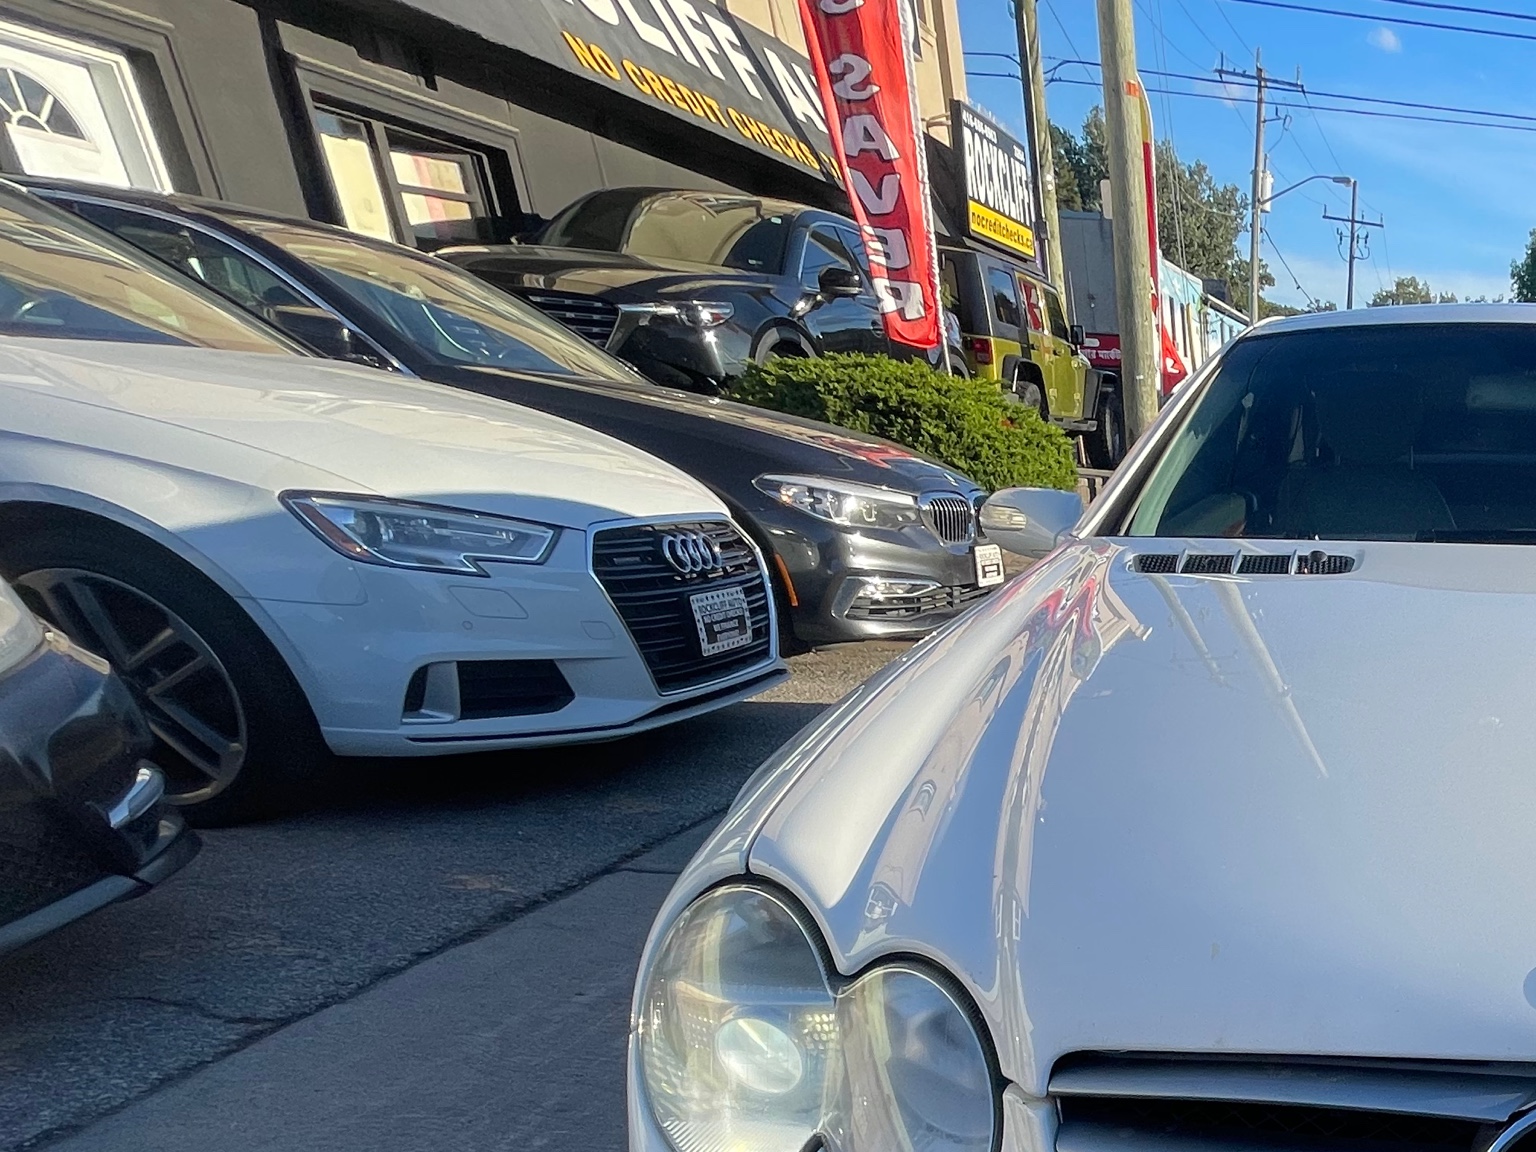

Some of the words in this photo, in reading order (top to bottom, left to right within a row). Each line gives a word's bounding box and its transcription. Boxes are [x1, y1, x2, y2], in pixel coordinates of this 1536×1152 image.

[561, 30, 622, 81] NO
[621, 59, 730, 129] CREDIT
[727, 107, 821, 171] CHECKS
[964, 126, 1032, 227] ROCKCLIFF
